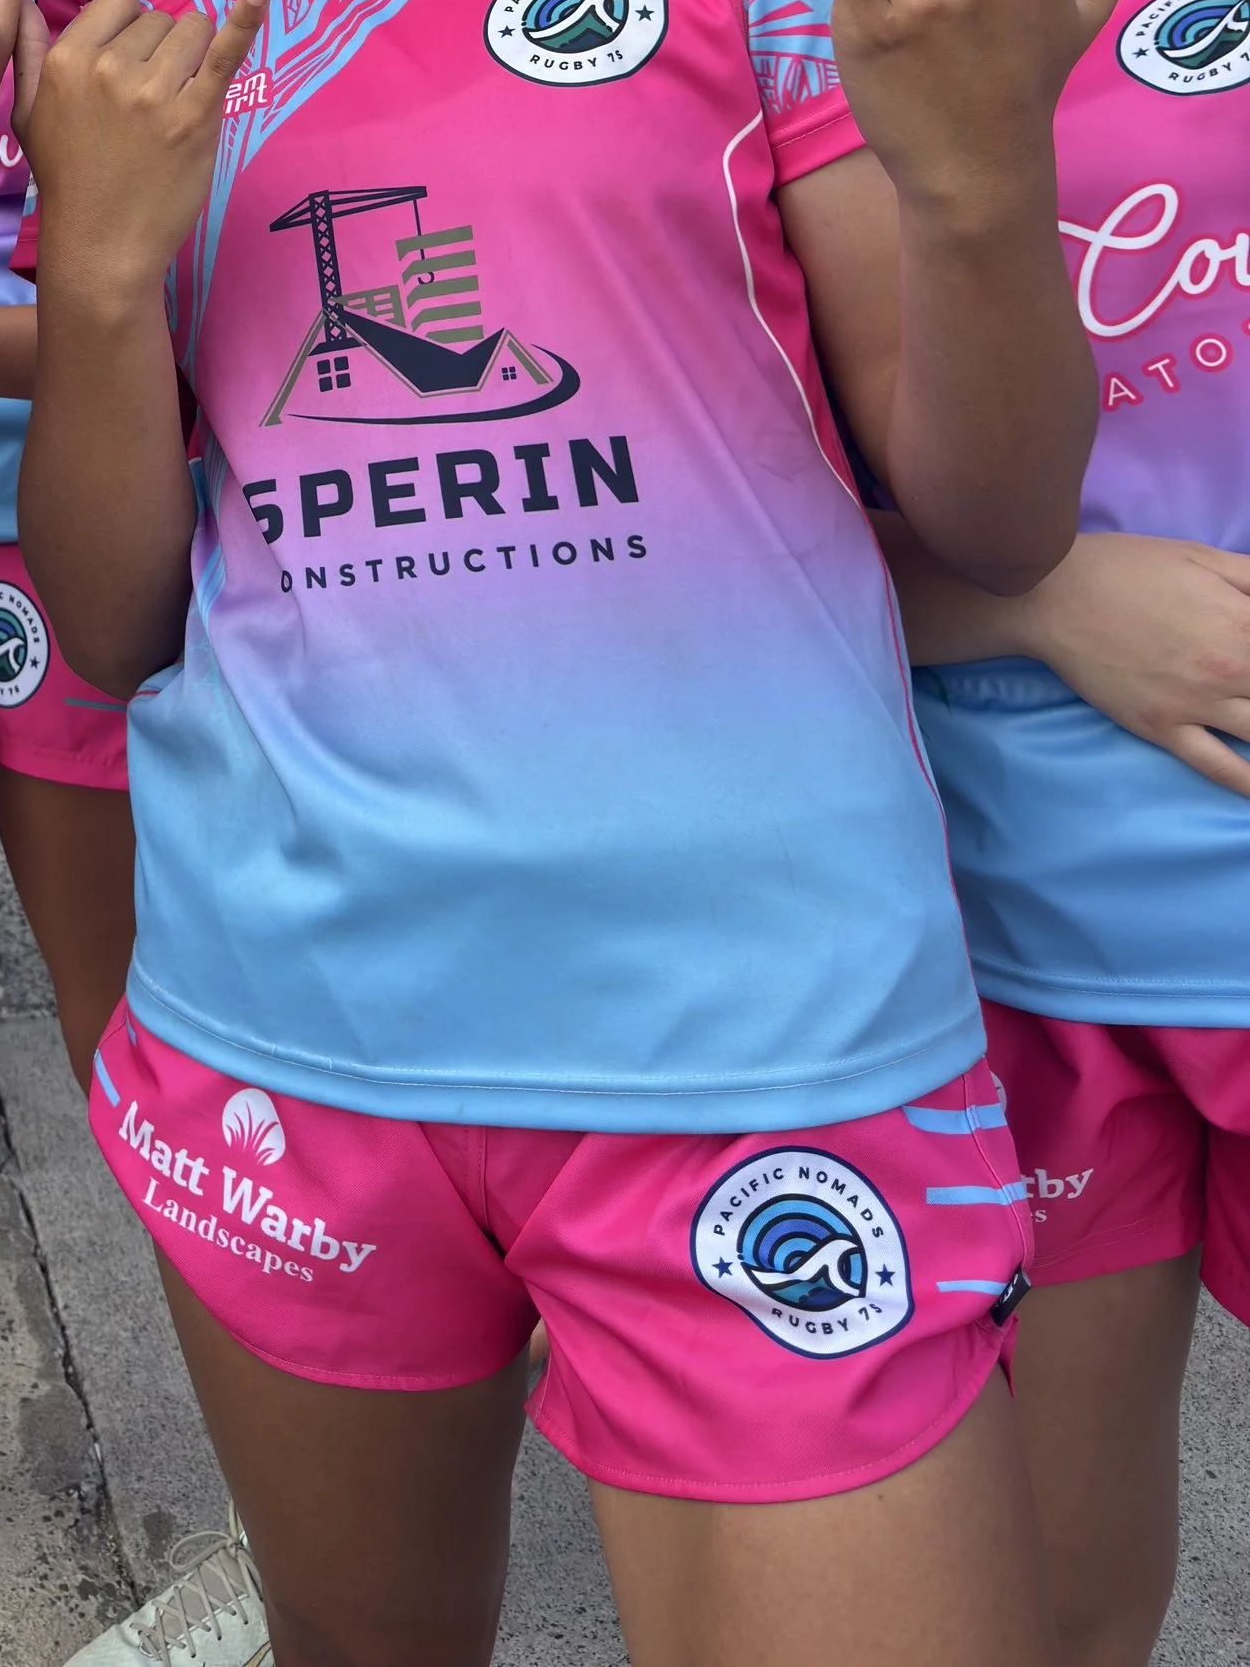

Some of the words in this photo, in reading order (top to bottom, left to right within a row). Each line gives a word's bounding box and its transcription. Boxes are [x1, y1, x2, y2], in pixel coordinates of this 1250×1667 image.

[529, 53, 598, 71] RUGBY
[1168, 62, 1232, 83] RUGBY
[1108, 338, 1227, 406] ATO
[242, 435, 640, 545] SPERIN
[280, 534, 647, 593] ONSTRUCTIONS
[9, 594, 40, 643] NOMADS
[118, 1100, 210, 1196] Matt
[222, 1165, 377, 1273] Warby
[712, 1167, 784, 1236] PACIFIC
[799, 1166, 884, 1238] NOMADS
[142, 1176, 314, 1282] Landscapes
[771, 1307, 850, 1335] RUGBY
